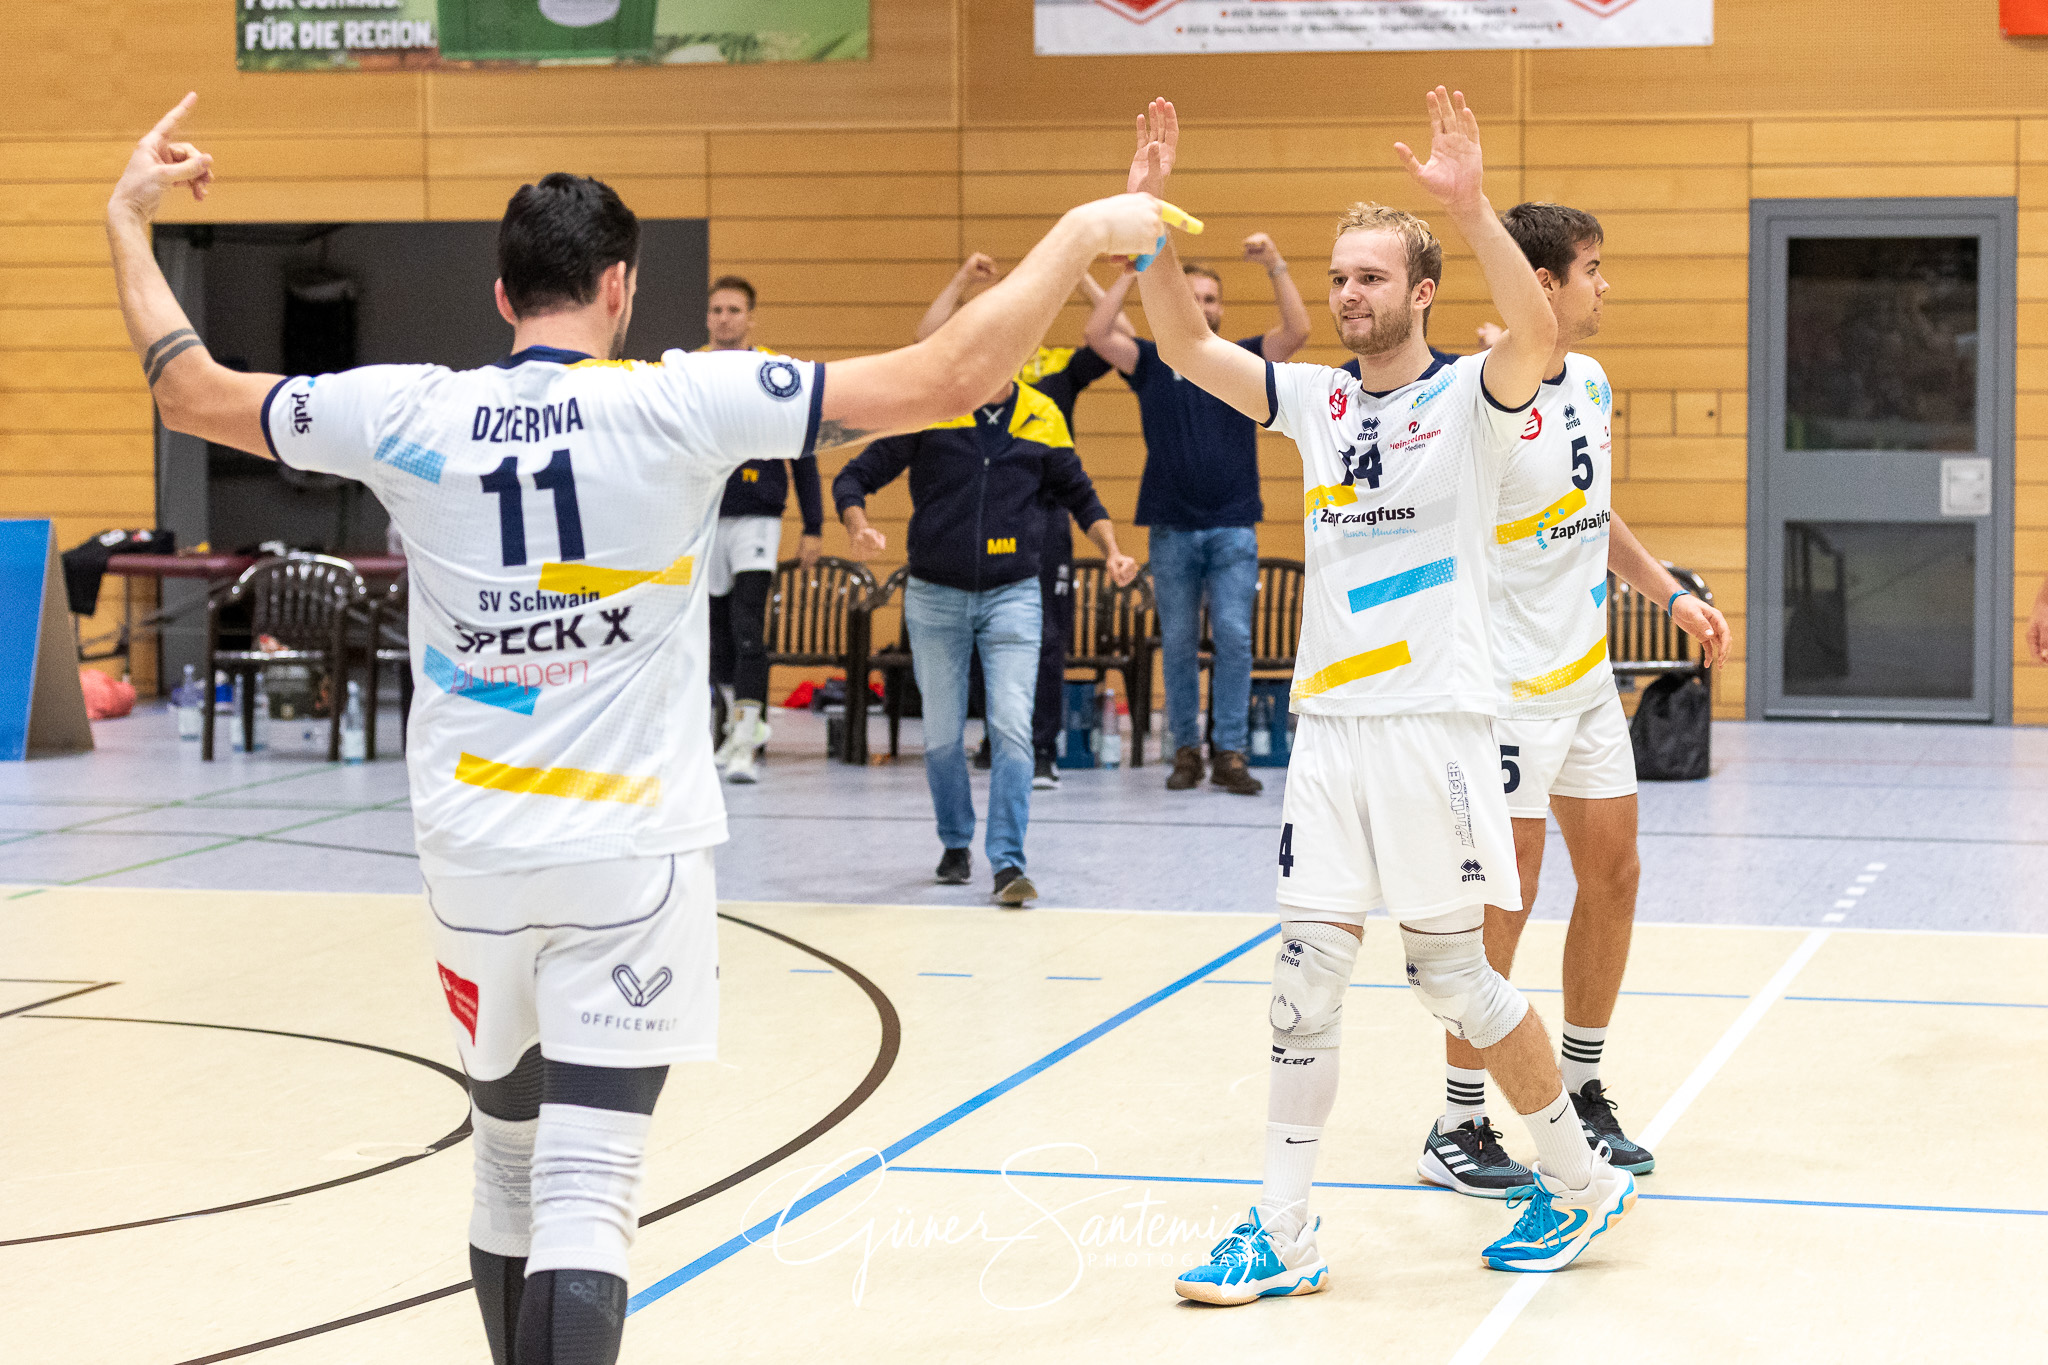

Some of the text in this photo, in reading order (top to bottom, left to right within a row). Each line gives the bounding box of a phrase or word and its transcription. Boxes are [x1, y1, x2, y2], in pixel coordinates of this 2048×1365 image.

[245, 16, 294, 50] FÜR
[299, 21, 340, 49] DIE
[291, 393, 312, 434] puls
[1571, 435, 1594, 491] 5
[480, 448, 586, 567] 11
[479, 589, 501, 612] SV
[454, 614, 587, 655] SPECK
[450, 659, 589, 696] pumpen
[1500, 744, 1520, 794] 5
[1278, 822, 1295, 878] 4
[1461, 873, 1486, 883] errea
[1280, 953, 1300, 968] errea
[1282, 1056, 1316, 1066] cep
